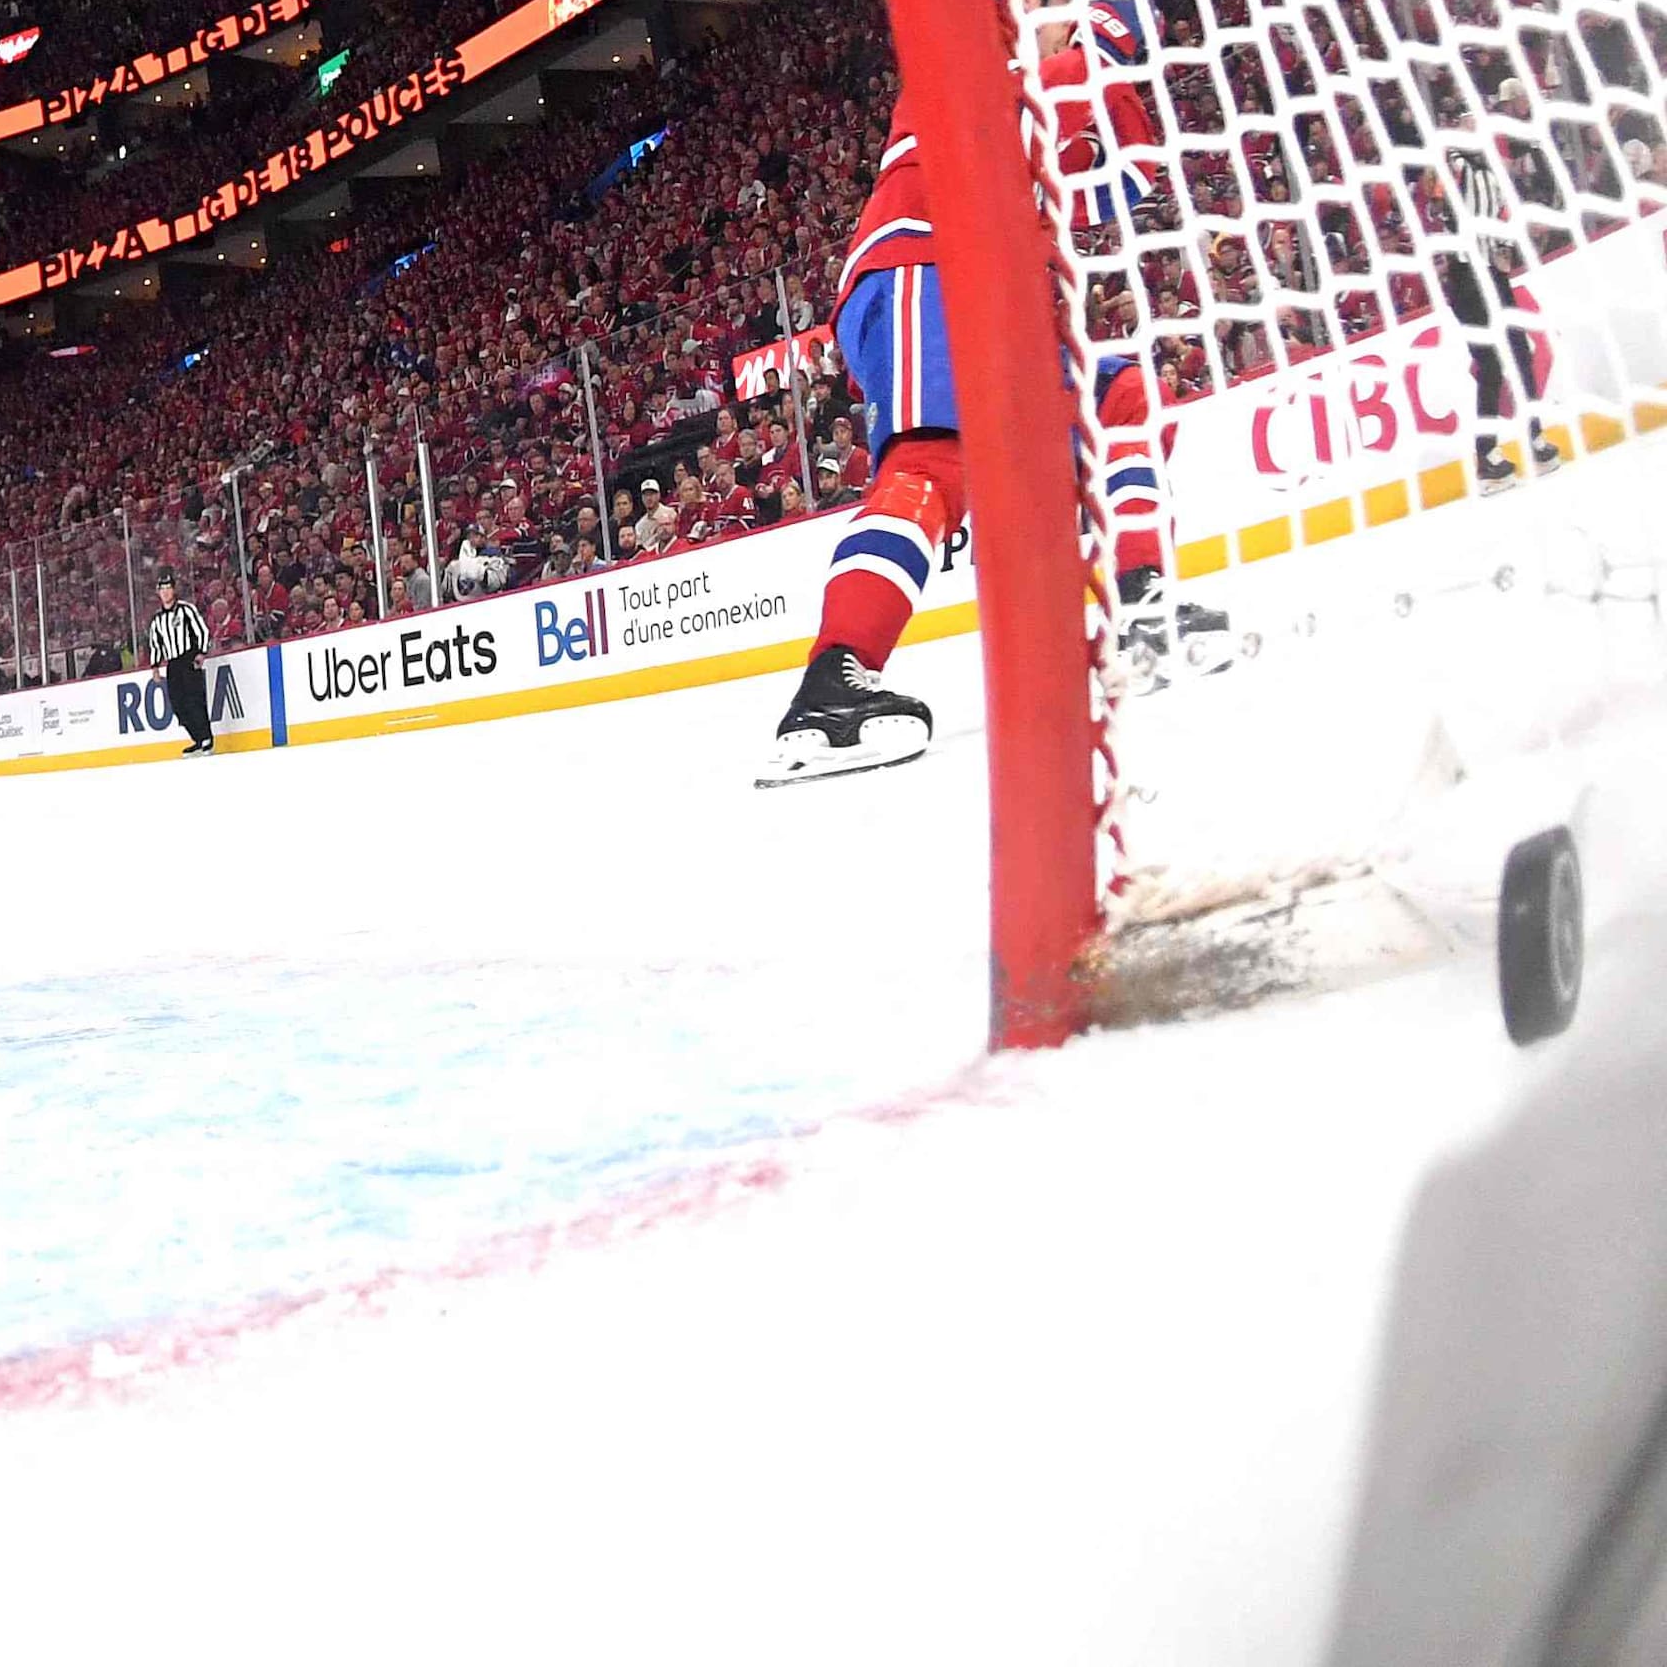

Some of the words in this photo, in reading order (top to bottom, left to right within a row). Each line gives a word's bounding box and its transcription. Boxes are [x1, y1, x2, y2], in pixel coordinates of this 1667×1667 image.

[44, 61, 139, 126] PIZZA
[42, 229, 142, 288] PIZZA
[325, 57, 468, 160] POUCES
[1251, 327, 1460, 490] CIBC
[533, 587, 610, 667] Bell
[618, 583, 663, 614] Tout
[667, 570, 712, 610] part
[622, 619, 674, 648] d'une
[679, 592, 787, 636] connexion
[116, 664, 245, 734] ROA
[306, 642, 393, 703] Uber
[399, 621, 498, 690] Eats
